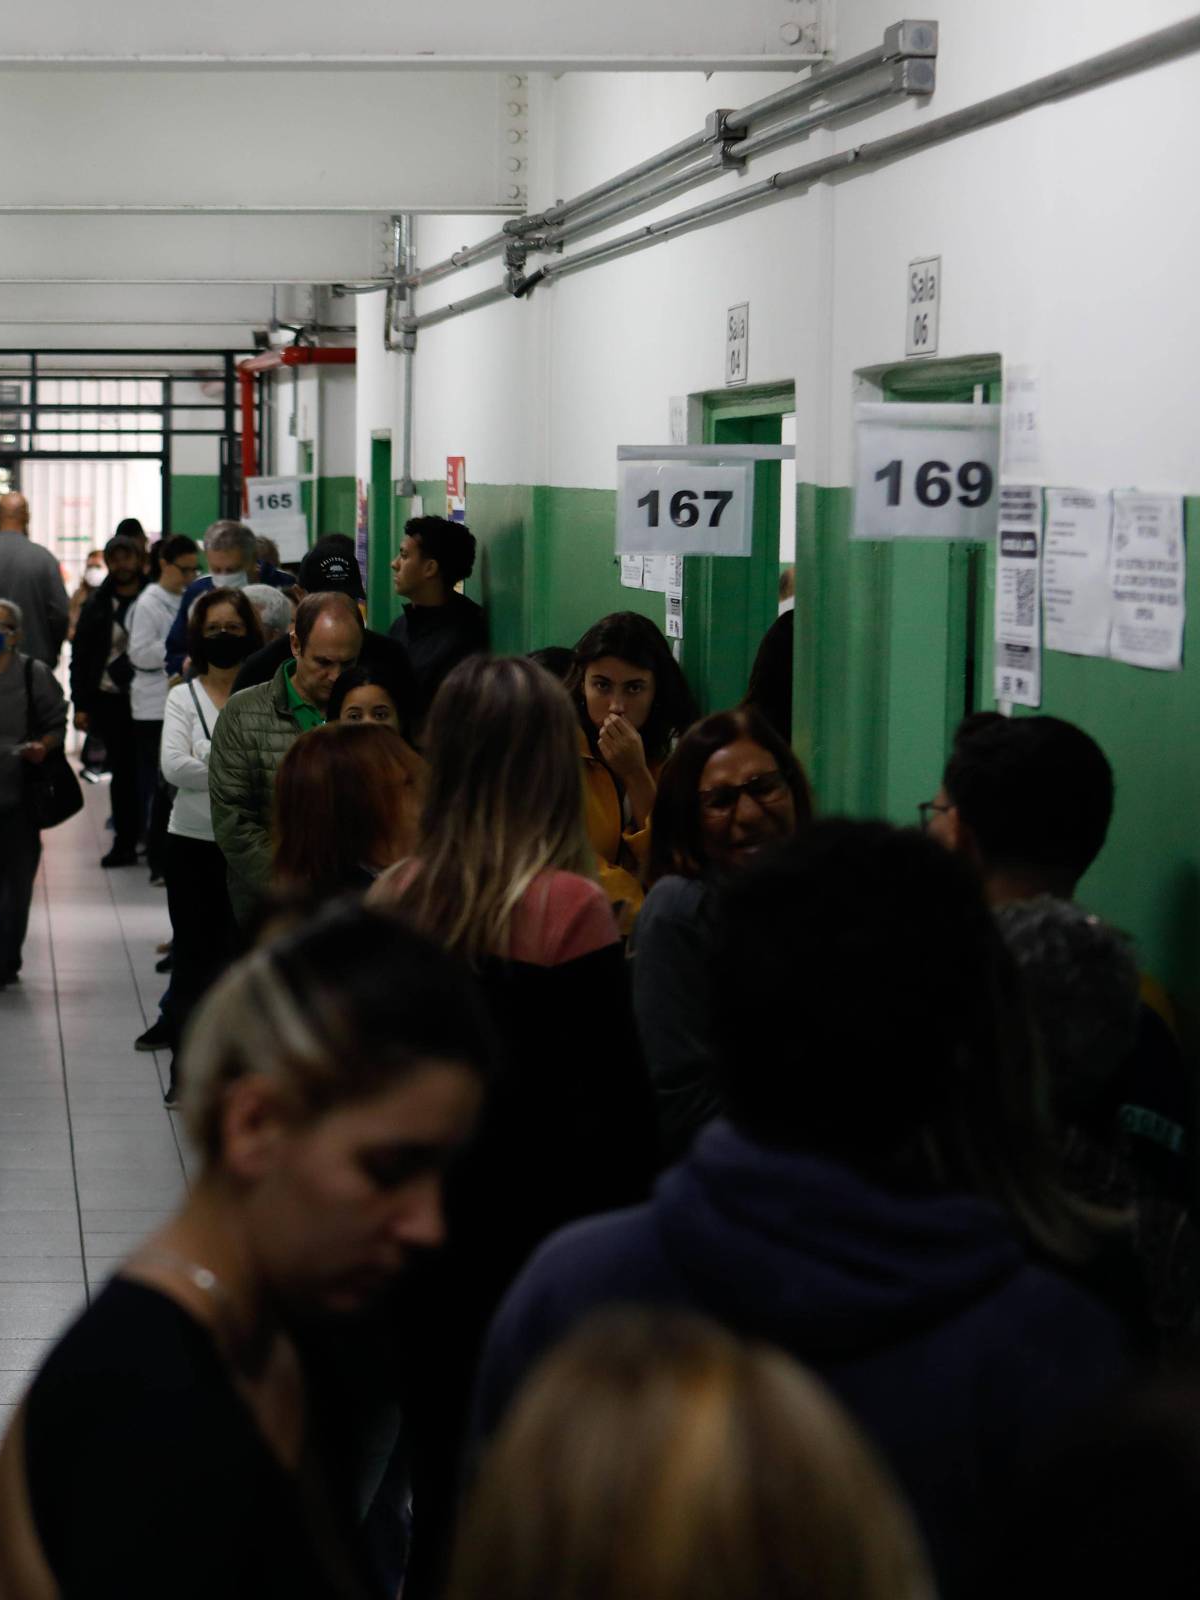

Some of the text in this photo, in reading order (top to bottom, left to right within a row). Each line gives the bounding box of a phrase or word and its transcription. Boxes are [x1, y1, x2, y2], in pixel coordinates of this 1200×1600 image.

[910, 266, 936, 305] Sala
[728, 315, 745, 342] Sala
[913, 312, 928, 346] 06
[730, 349, 741, 375] 04
[874, 459, 994, 508] 169
[255, 492, 293, 511] 165
[636, 488, 735, 528] 167
